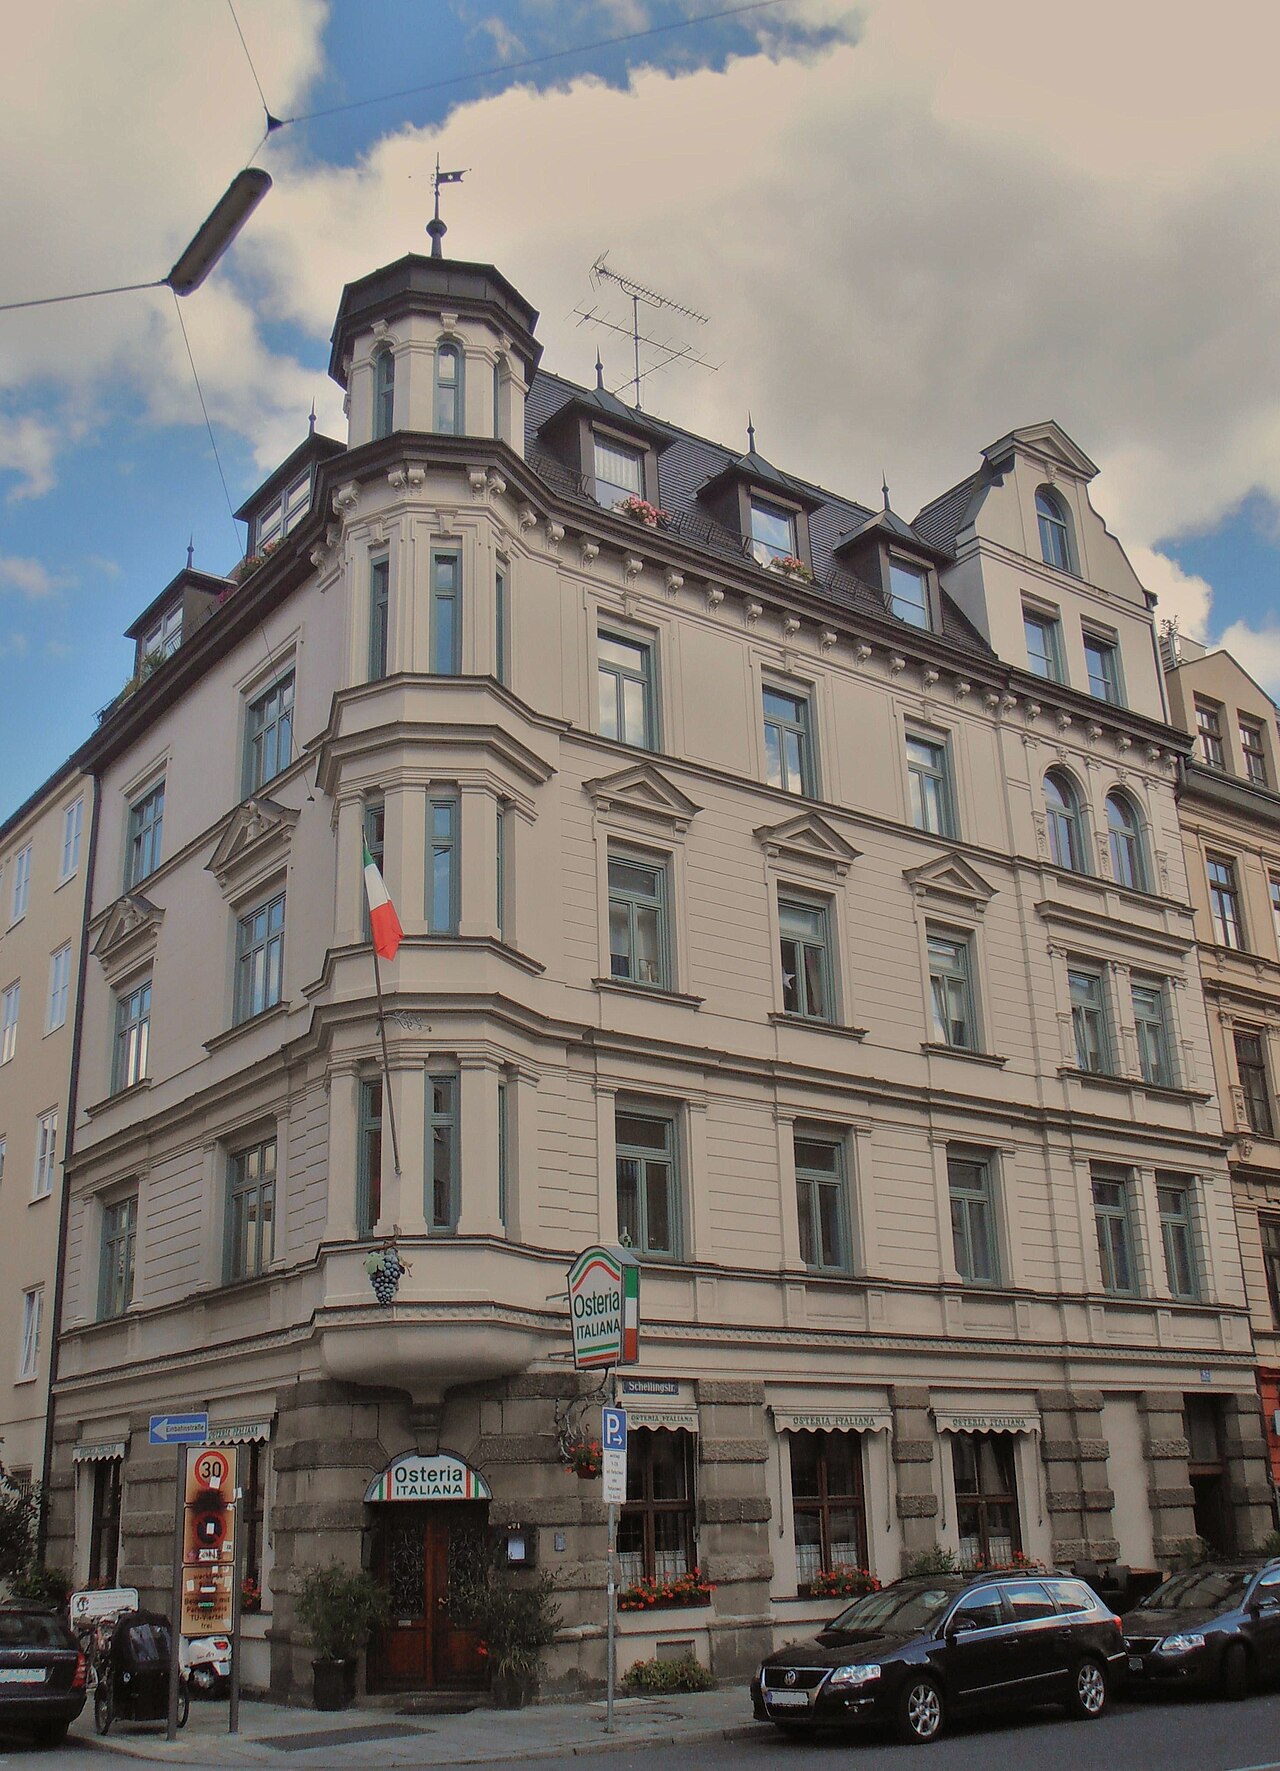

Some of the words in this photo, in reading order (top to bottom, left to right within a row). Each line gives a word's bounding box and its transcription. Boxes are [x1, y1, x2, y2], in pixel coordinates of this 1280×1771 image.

[574, 1287, 620, 1319] Osteria
[576, 1319, 621, 1340] ITALIANA
[629, 1381, 676, 1394] Schellingstr.
[631, 1414, 659, 1422] OSTERIA
[663, 1415, 694, 1423] ITALIANA
[793, 1416, 831, 1425] OSTERIA
[835, 1416, 876, 1426] ITALIANA
[953, 1418, 987, 1427] OSTERIA
[990, 1418, 1026, 1427] ITALIANA
[166, 1423, 205, 1433] Einbahnstraße
[606, 1413, 620, 1445] P
[201, 1461, 221, 1478] 30
[395, 1465, 463, 1483] Osteria
[396, 1484, 464, 1496] ITALIANA
